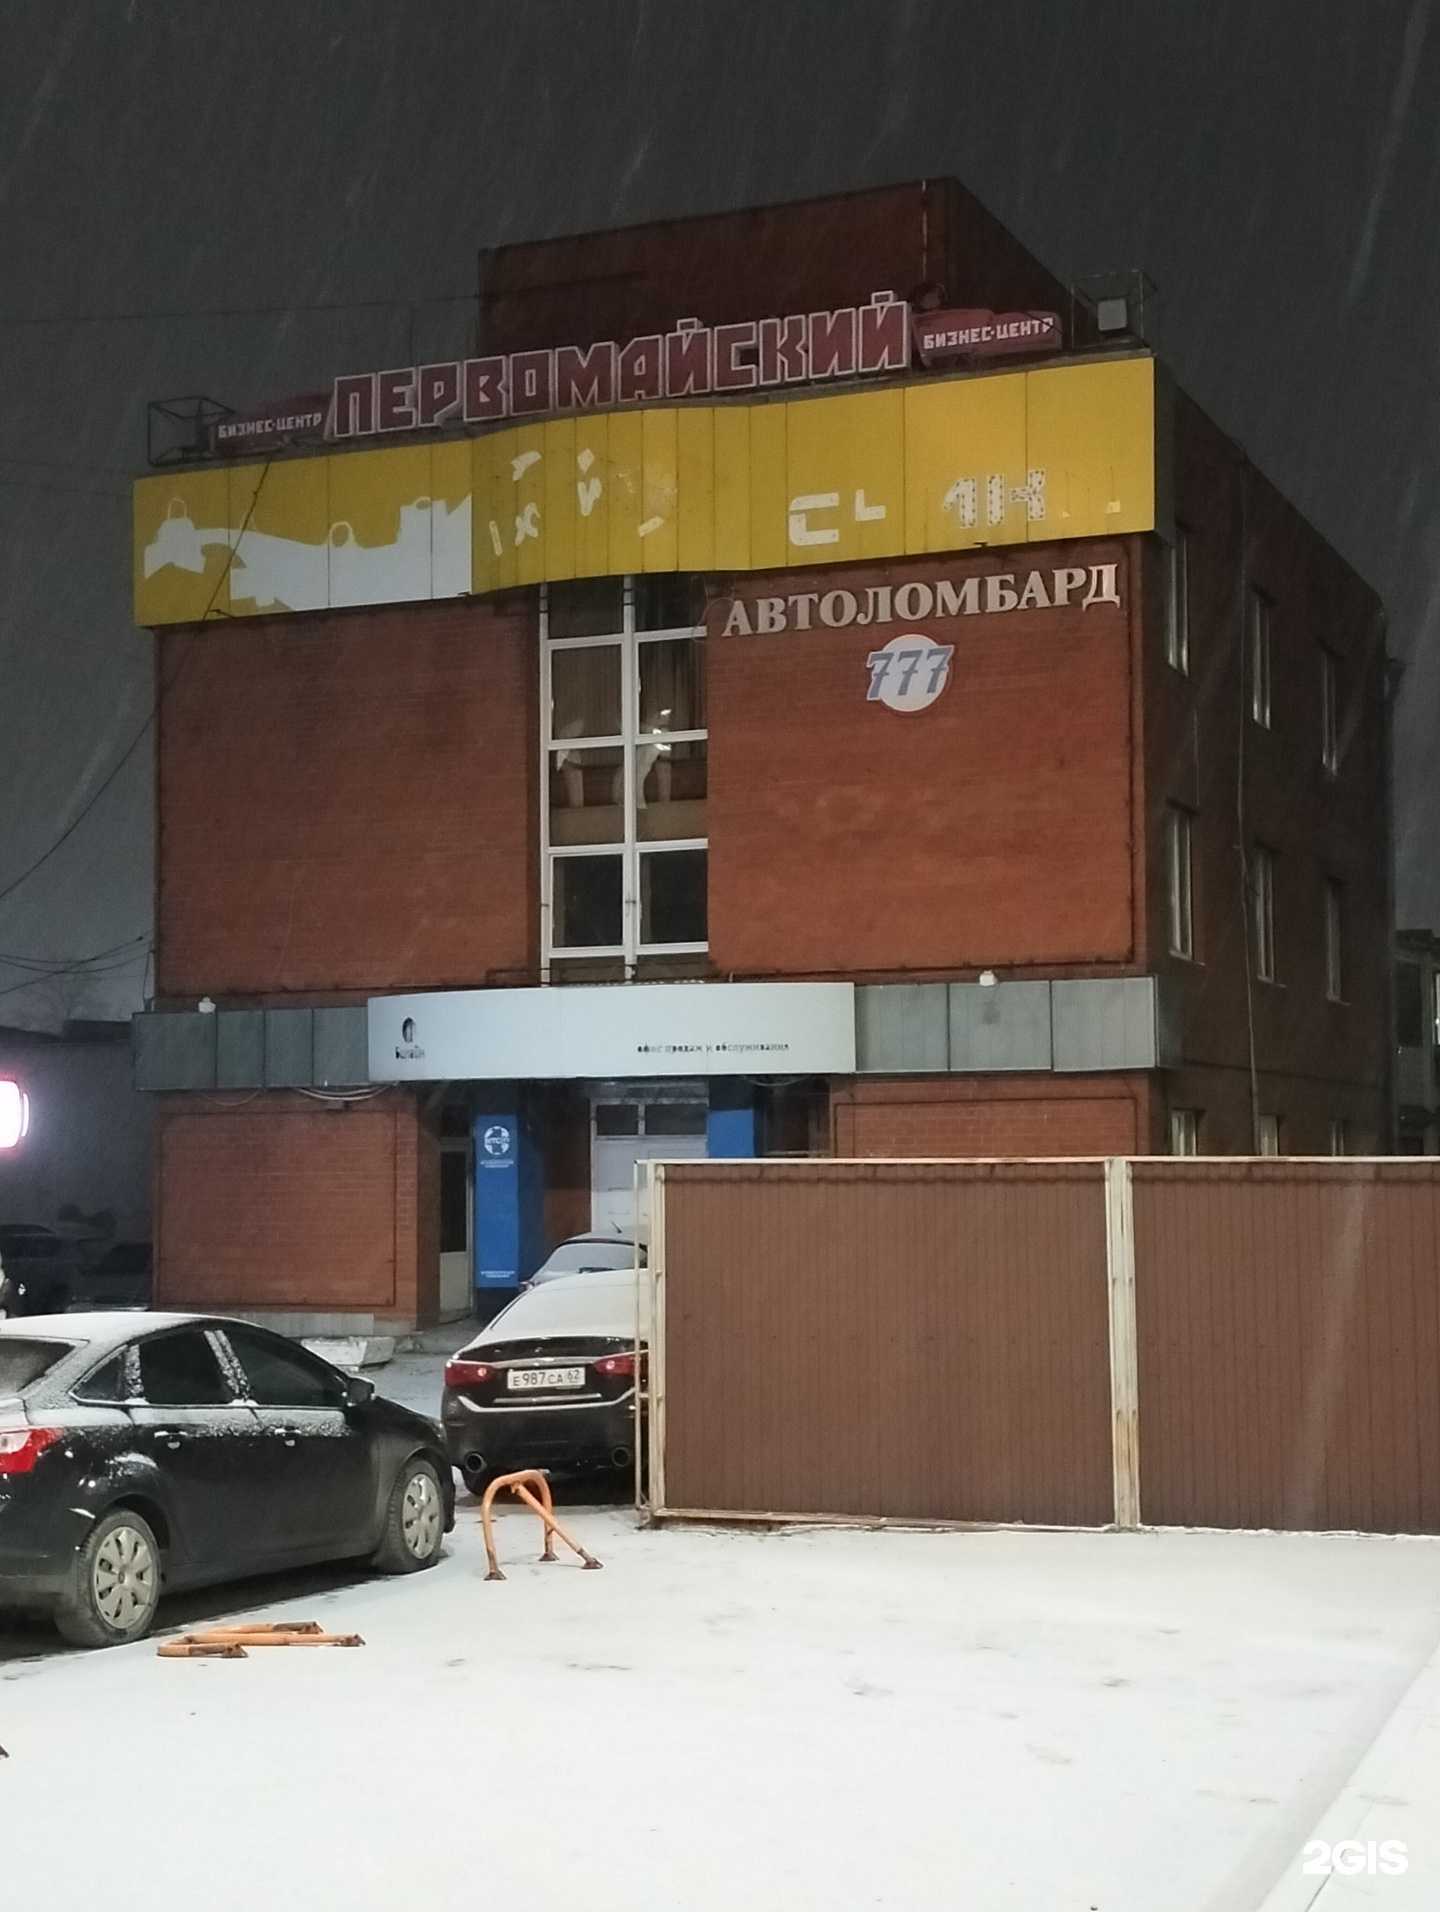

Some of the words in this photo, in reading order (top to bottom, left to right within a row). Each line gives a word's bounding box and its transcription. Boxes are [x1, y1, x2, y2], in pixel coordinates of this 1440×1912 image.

[332, 290, 909, 438] ПЕРВОМАЙСКИЙ
[721, 563, 1121, 639] АВТОЛОМБАРД
[866, 644, 954, 701] 777
